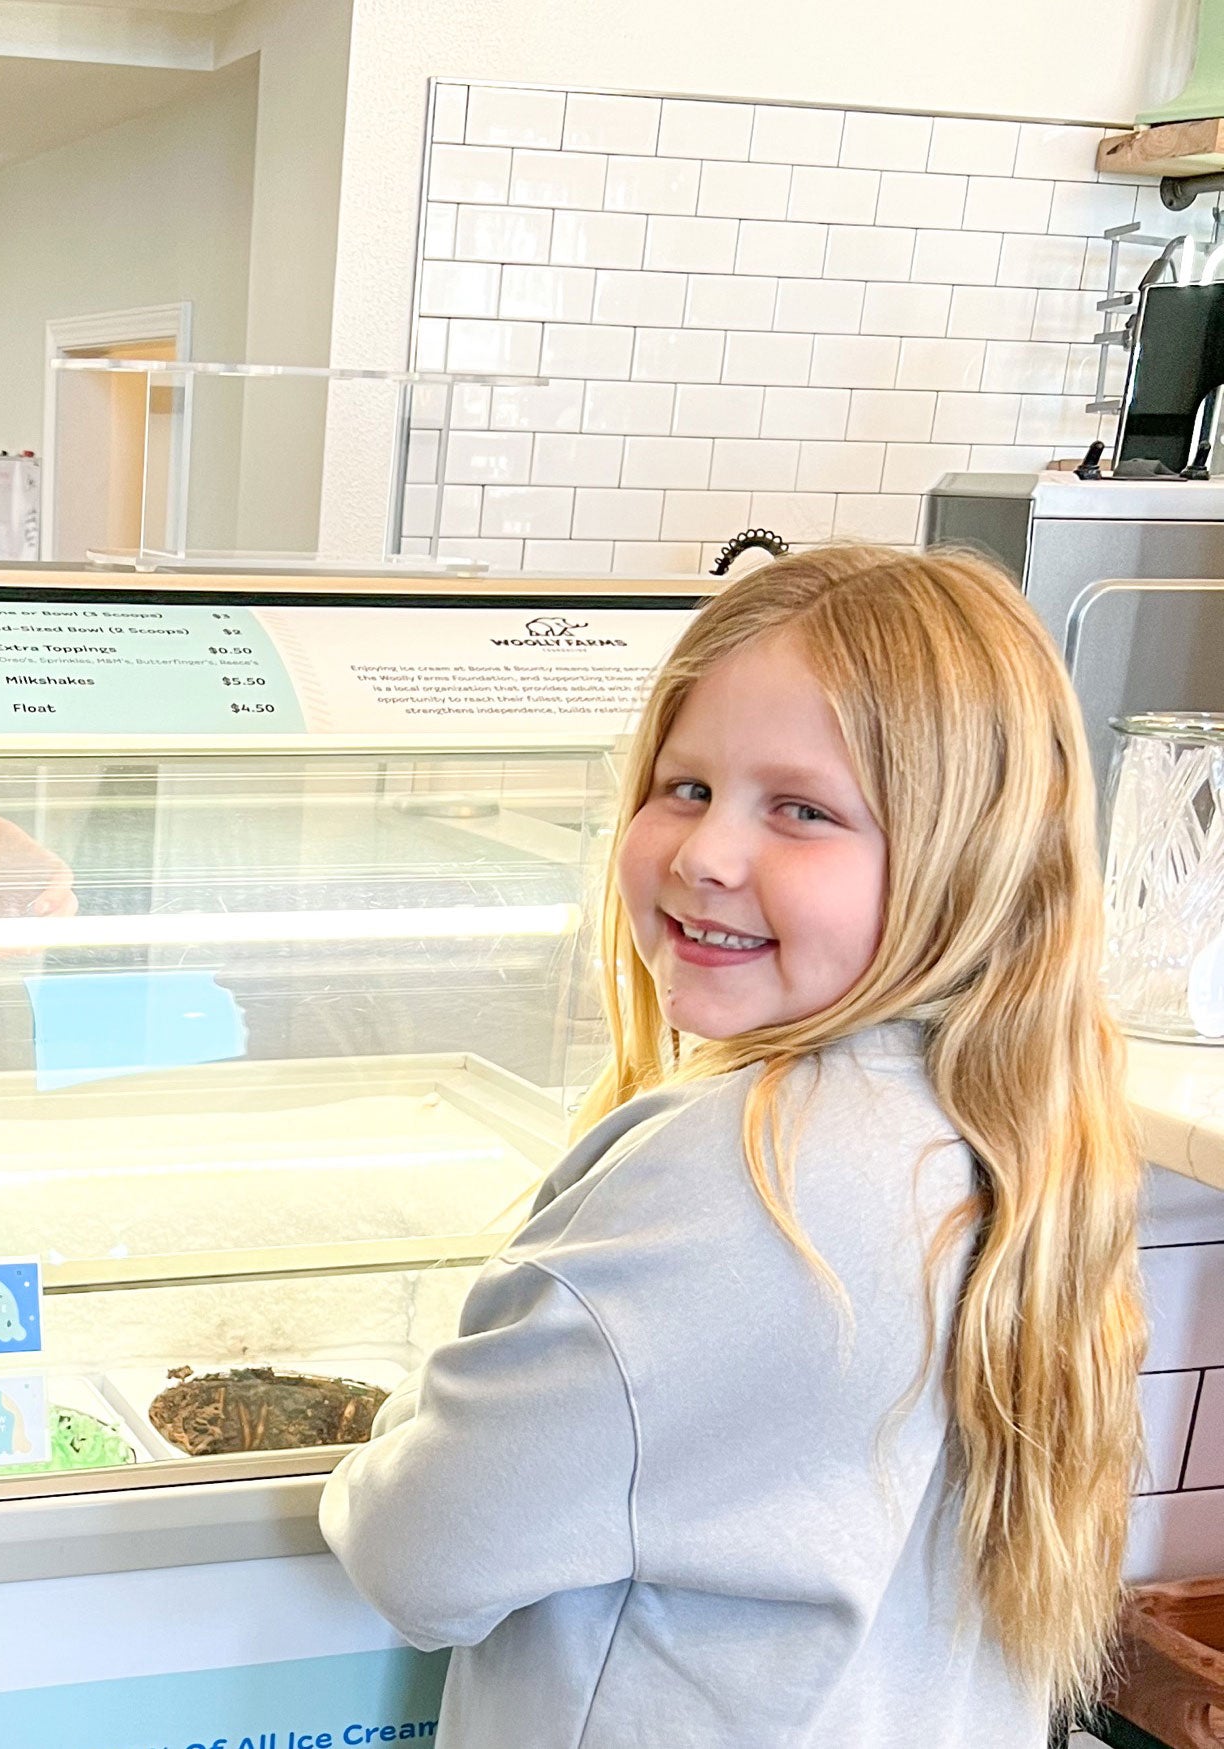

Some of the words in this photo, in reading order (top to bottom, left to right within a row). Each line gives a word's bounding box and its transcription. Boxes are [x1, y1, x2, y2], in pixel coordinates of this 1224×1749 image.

[490, 639, 560, 647] WOOLLY
[566, 639, 627, 647] FARMS
[43, 645, 117, 654] Toppings
[208, 646, 252, 655] $0.50
[350, 665, 397, 673] Enjoying
[5, 675, 95, 687] Milkshakes
[222, 675, 266, 687] $5.50
[380, 675, 414, 683] Woolly
[452, 675, 517, 683] Foundation,
[423, 685, 492, 693] organization
[13, 702, 56, 714] Float
[231, 702, 275, 715] $4.50
[405, 707, 474, 715] strengthens
[477, 707, 556, 715] independence,
[239, 1733, 275, 1749] All
[289, 1732, 332, 1749] Ice
[343, 1719, 439, 1745] Cream
